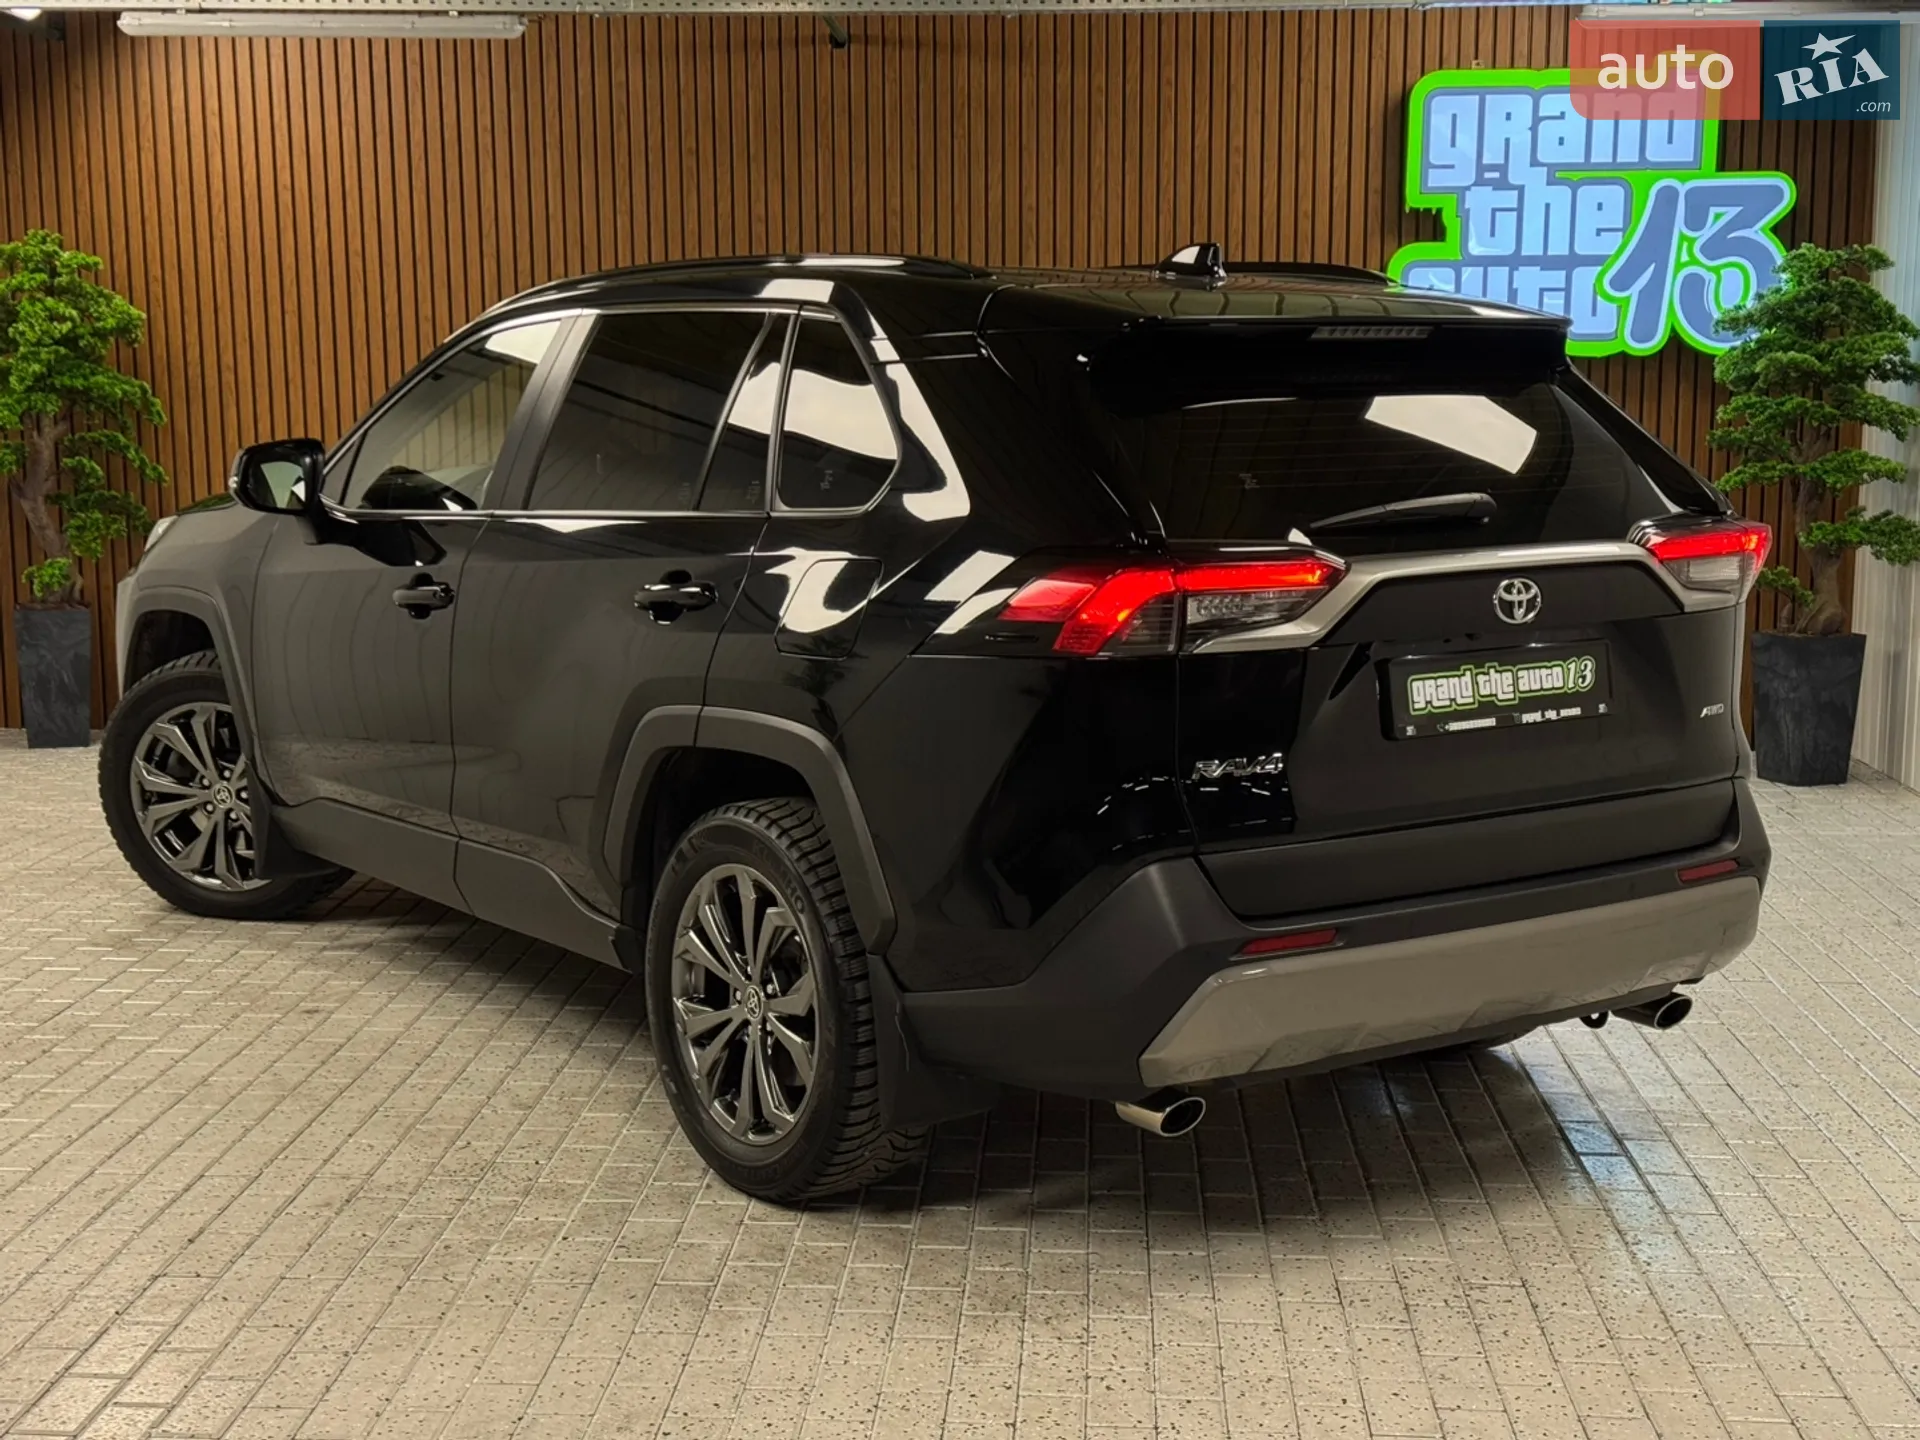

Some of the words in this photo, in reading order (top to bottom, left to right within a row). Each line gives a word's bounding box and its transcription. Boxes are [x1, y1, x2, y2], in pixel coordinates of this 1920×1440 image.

[1465, 166, 1627, 258] the
[1604, 178, 1790, 350] 13
[1477, 668, 1515, 700] the
[1191, 752, 1283, 779] RAV4
